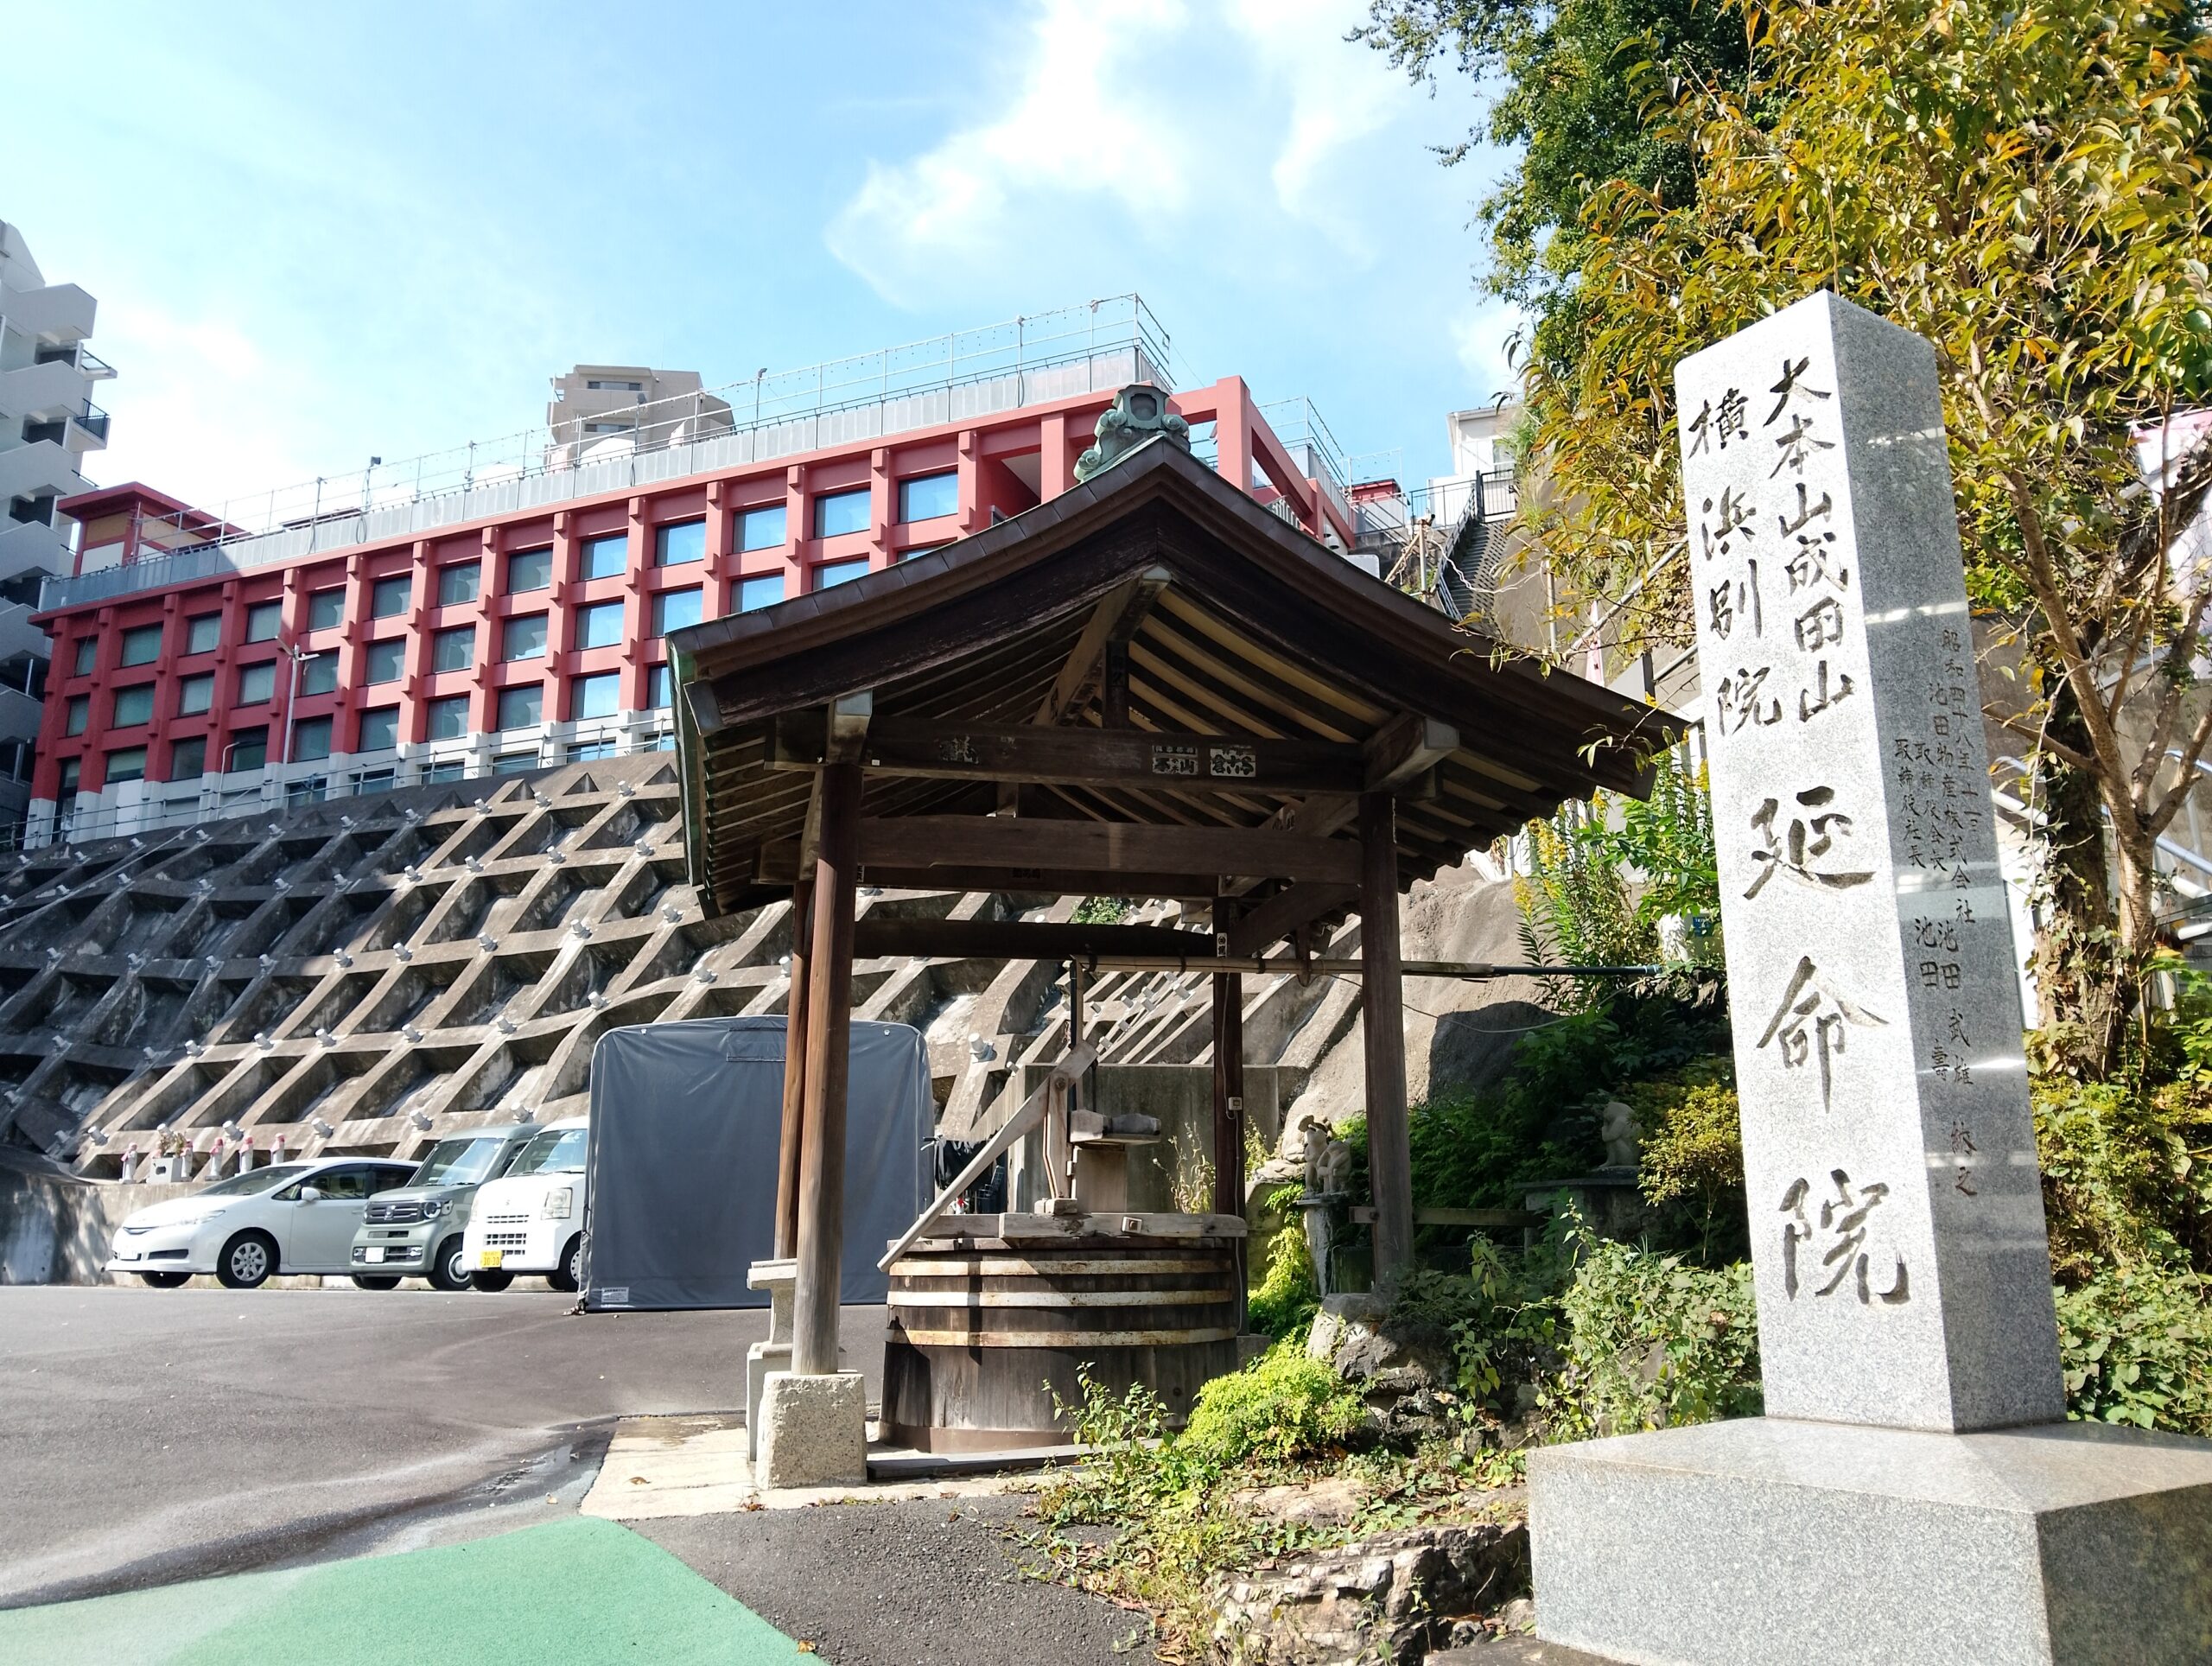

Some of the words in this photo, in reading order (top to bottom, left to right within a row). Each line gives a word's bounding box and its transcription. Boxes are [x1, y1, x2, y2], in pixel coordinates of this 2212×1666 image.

[1688, 387, 1782, 736] 横浜別院
[1742, 785, 1910, 1306] 延命院
